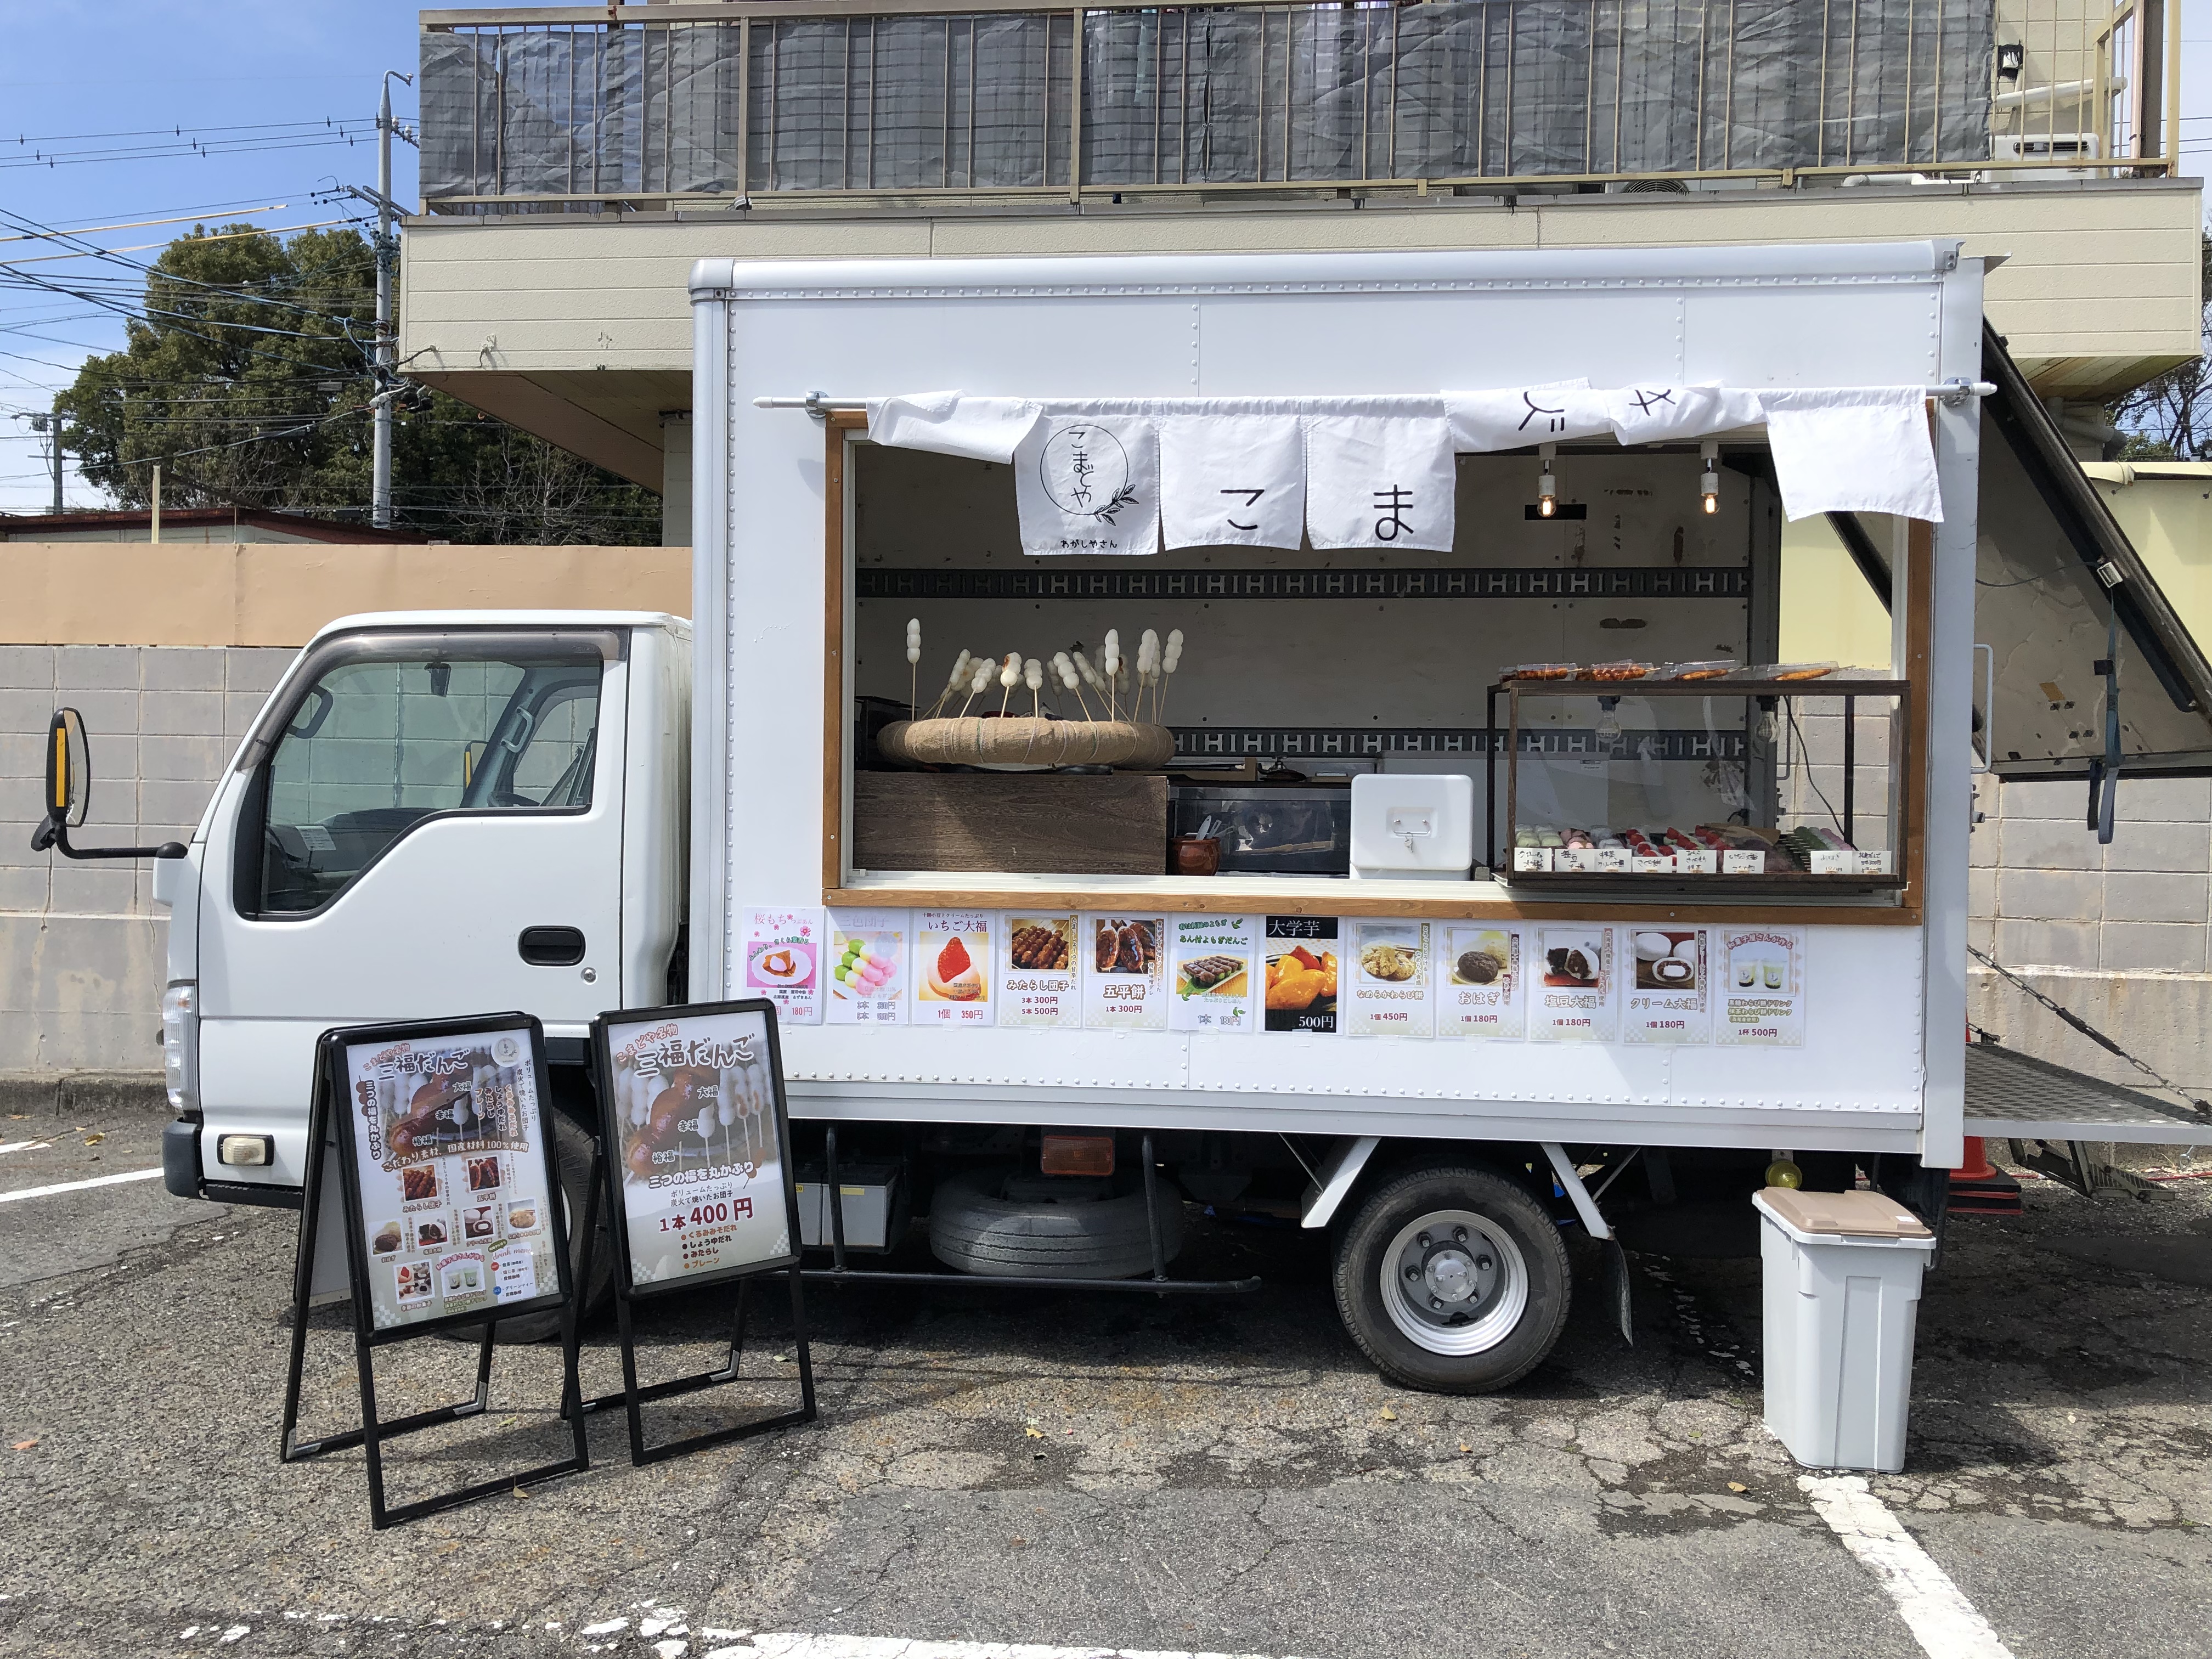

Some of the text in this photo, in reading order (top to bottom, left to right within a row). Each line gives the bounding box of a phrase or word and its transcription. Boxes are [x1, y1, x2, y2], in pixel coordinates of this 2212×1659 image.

[1068, 431, 1093, 508] こまどや
[1060, 539, 1118, 550] わがしやさん
[754, 913, 787, 925] 桜もち
[928, 920, 988, 933] いちご大福
[1268, 919, 1321, 937] 大学芋
[1726, 933, 1794, 950] 和菓子屋さんが作る
[1007, 979, 1070, 992] みたらし団子
[1103, 984, 1146, 1000] 五平餅
[1034, 996, 1058, 1005] 300円
[1357, 990, 1424, 1000] なめらかわらび餅
[1458, 991, 1500, 1006] おはぎ
[1544, 994, 1597, 1009] 塩豆大福
[1118, 1005, 1142, 1014] 300円
[1630, 997, 1698, 1011] クリーム大福
[1728, 998, 1792, 1007] 黒糖わらび餅ドリンク
[792, 1007, 812, 1016] 180円
[938, 1008, 983, 1019] 1個 350円
[1034, 1007, 1058, 1015] 500円
[1383, 1013, 1408, 1022] 450円
[1728, 1007, 1792, 1016] 抹茶わらび餅ドリンク
[1198, 1014, 1241, 1026] 1本 180円
[1299, 1015, 1334, 1029] 500円
[1473, 1015, 1498, 1024] 180円
[1565, 1018, 1591, 1027] 180円
[1659, 1020, 1685, 1029] 180円
[1751, 1028, 1778, 1037] 500円
[616, 1023, 679, 1063] こまどや名物
[363, 1042, 411, 1071] こまどや名物
[634, 1032, 755, 1078] 三福だんご
[379, 1048, 470, 1081] 三福だんご
[452, 1080, 472, 1093] 大福
[524, 1059, 537, 1122] ボリュームたっぷり
[696, 1085, 719, 1099] 大福
[475, 1087, 486, 1120] プレーン
[484, 1086, 495, 1119] みたらし
[517, 1069, 529, 1131] 炭火で焼いたお団子
[435, 1108, 454, 1120] 幸福
[495, 1085, 507, 1132] しょうゆだれ
[505, 1084, 518, 1137] くるみみそだれ
[365, 1080, 382, 1160] 三つの福を丸かぶり
[677, 1118, 699, 1133] 幸福
[412, 1133, 433, 1147] 裕福
[651, 1149, 676, 1165] 裕福
[648, 1161, 754, 1189] 三つの福を丸かぶり
[671, 1181, 733, 1198] ボリュームたっぷり
[477, 1192, 496, 1202] 五平餅
[670, 1189, 734, 1207] 炭火で焼いたお団子
[403, 1200, 442, 1213] みたらし団子
[659, 1197, 754, 1232] 1本 400円
[688, 1224, 738, 1239] くるみみそだれ
[690, 1234, 732, 1249] しょうゆだれ
[493, 1246, 512, 1261] drink
[690, 1247, 720, 1258] みたらし
[691, 1257, 720, 1268] プレーン
